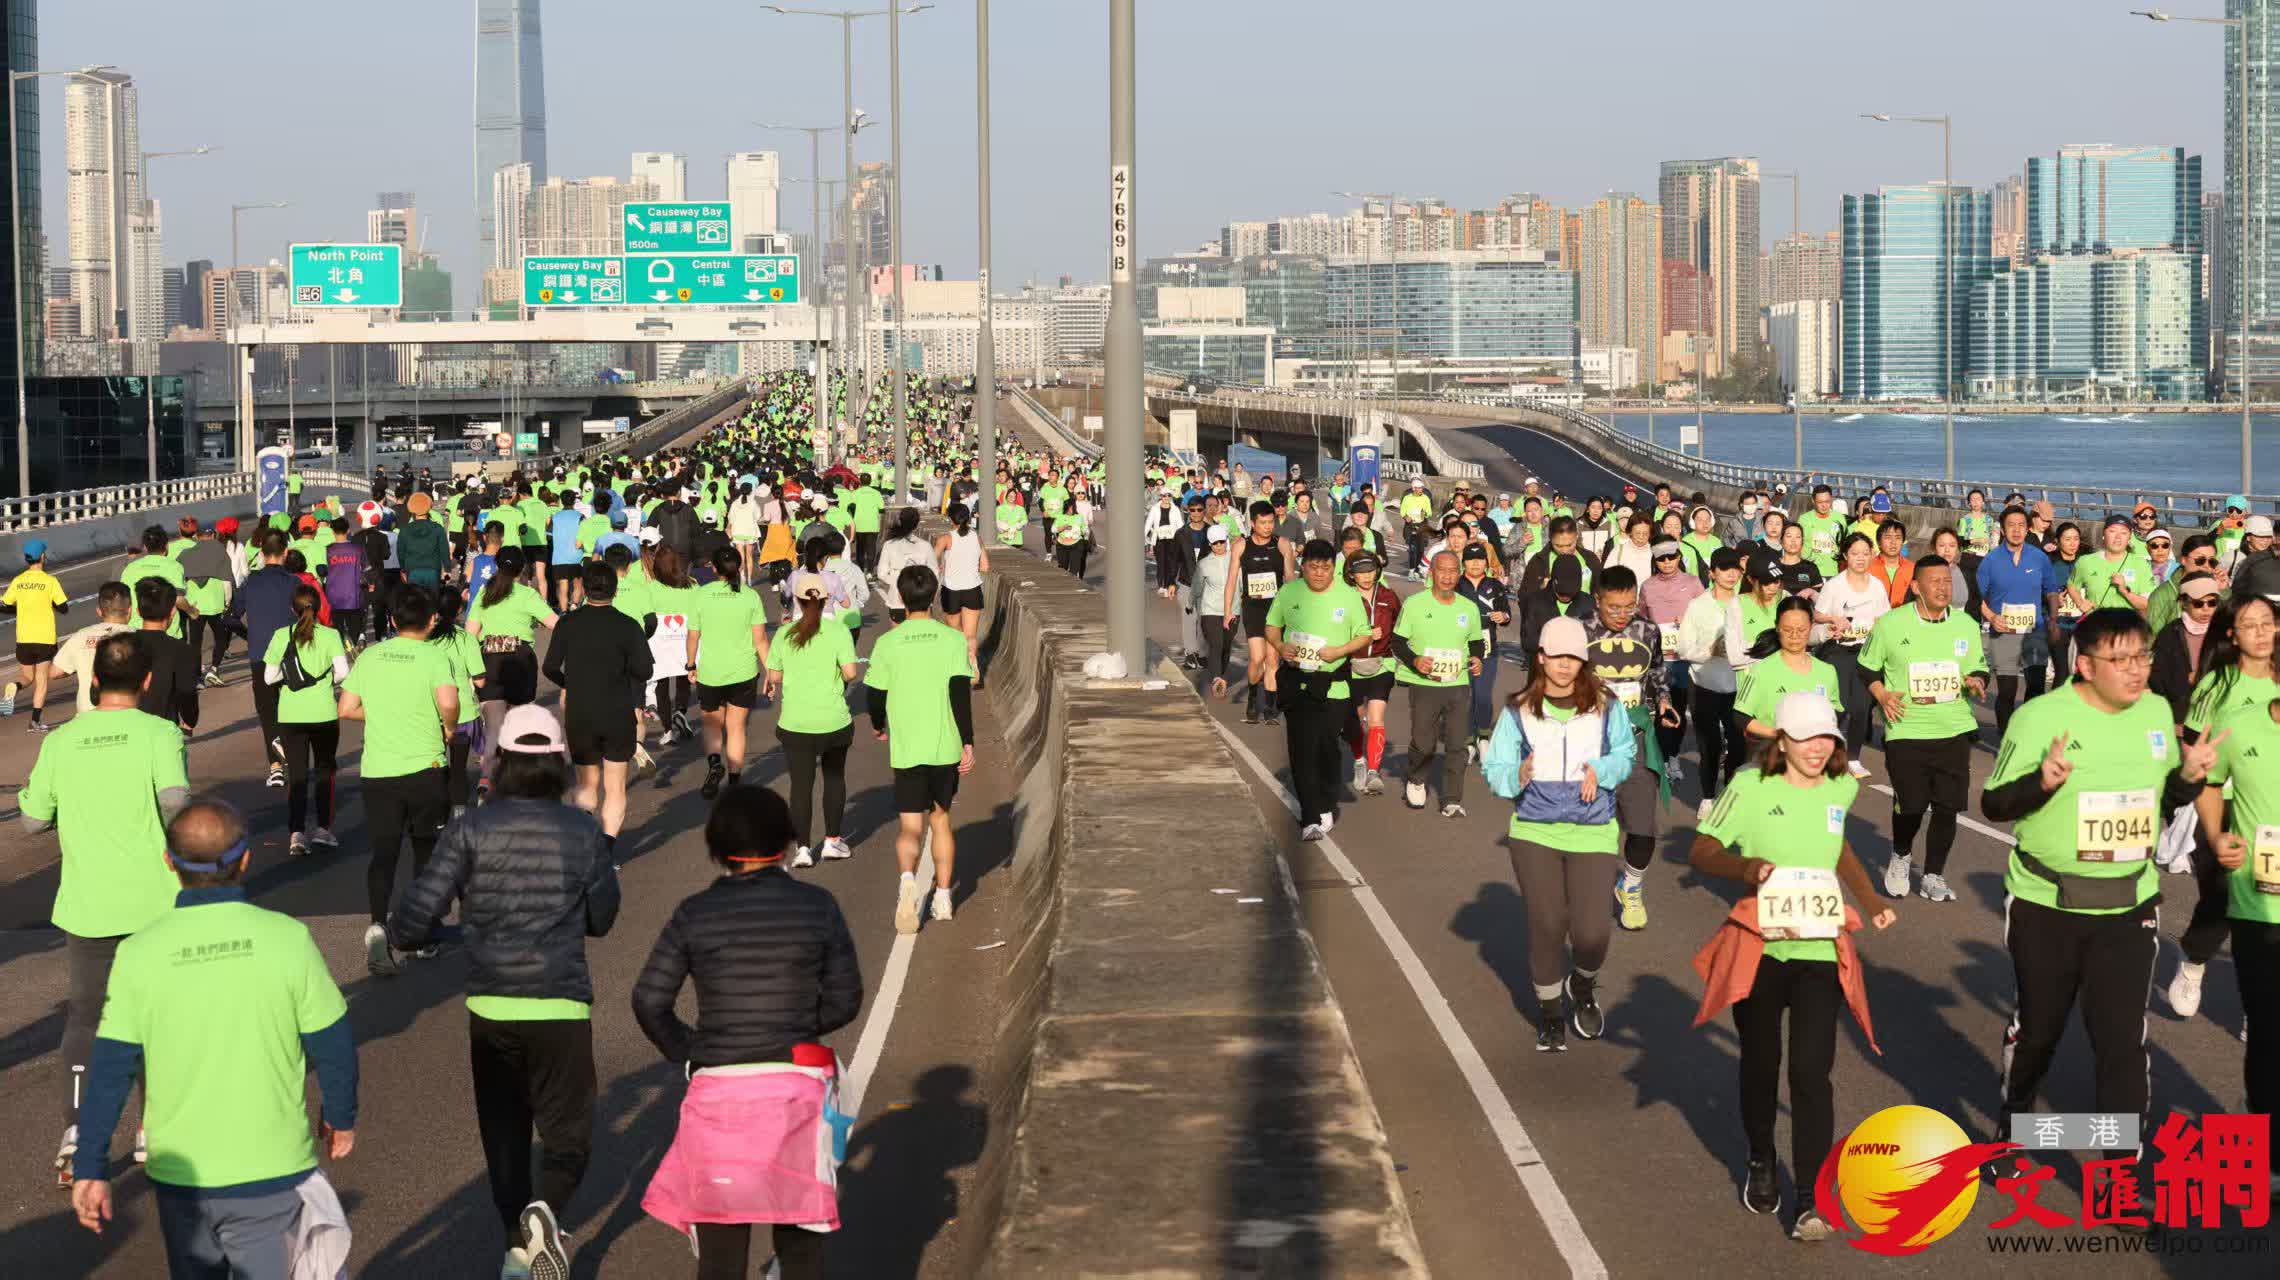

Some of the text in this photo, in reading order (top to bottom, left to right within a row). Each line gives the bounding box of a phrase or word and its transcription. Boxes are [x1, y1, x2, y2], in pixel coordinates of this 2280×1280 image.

[647, 207, 722, 218] Causeway Bay
[1114, 170, 1126, 270] 47669 B
[629, 240, 659, 249] 1500m
[308, 249, 384, 261] North Point
[528, 260, 602, 272] Causeway Bay
[691, 260, 731, 269] Central
[327, 267, 364, 285] 北角
[698, 273, 726, 287] 中區
[310, 287, 320, 302] 6
[1912, 676, 1959, 693] T3975
[2083, 815, 2152, 842] T0944
[1763, 895, 1840, 919] T4132
